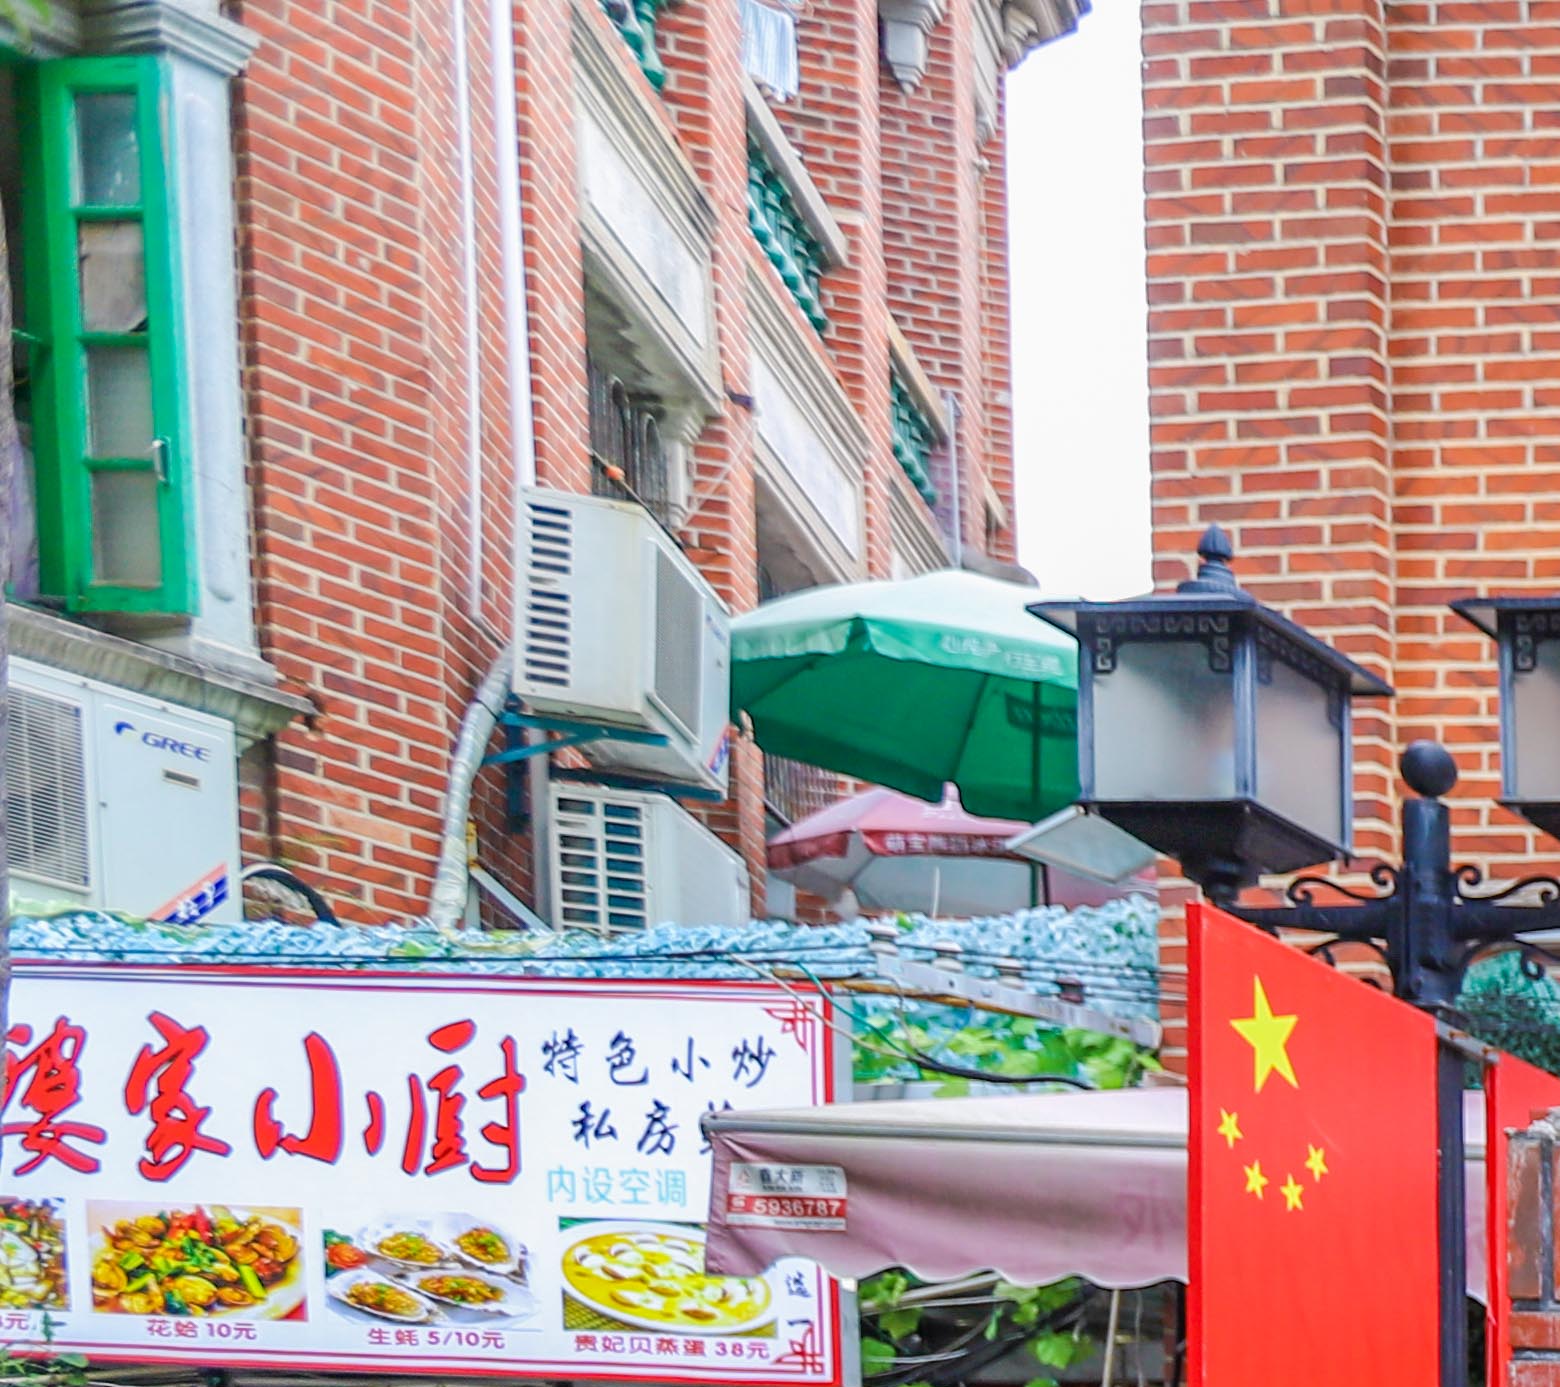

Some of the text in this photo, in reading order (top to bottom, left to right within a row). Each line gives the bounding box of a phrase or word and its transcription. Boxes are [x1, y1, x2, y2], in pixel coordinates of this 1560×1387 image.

[141, 731, 211, 763] GREE
[541, 1027, 777, 1088] 特色小炒
[546, 1166, 688, 1207] 内设空调
[753, 1197, 842, 1217] 5936787
[0, 1312, 29, 1331] 元
[147, 1319, 257, 1340] 花蛤 10元
[368, 1328, 506, 1349] 生蚝 5/10元
[574, 1335, 770, 1360] 贵妃贝蒸蛋 38元
